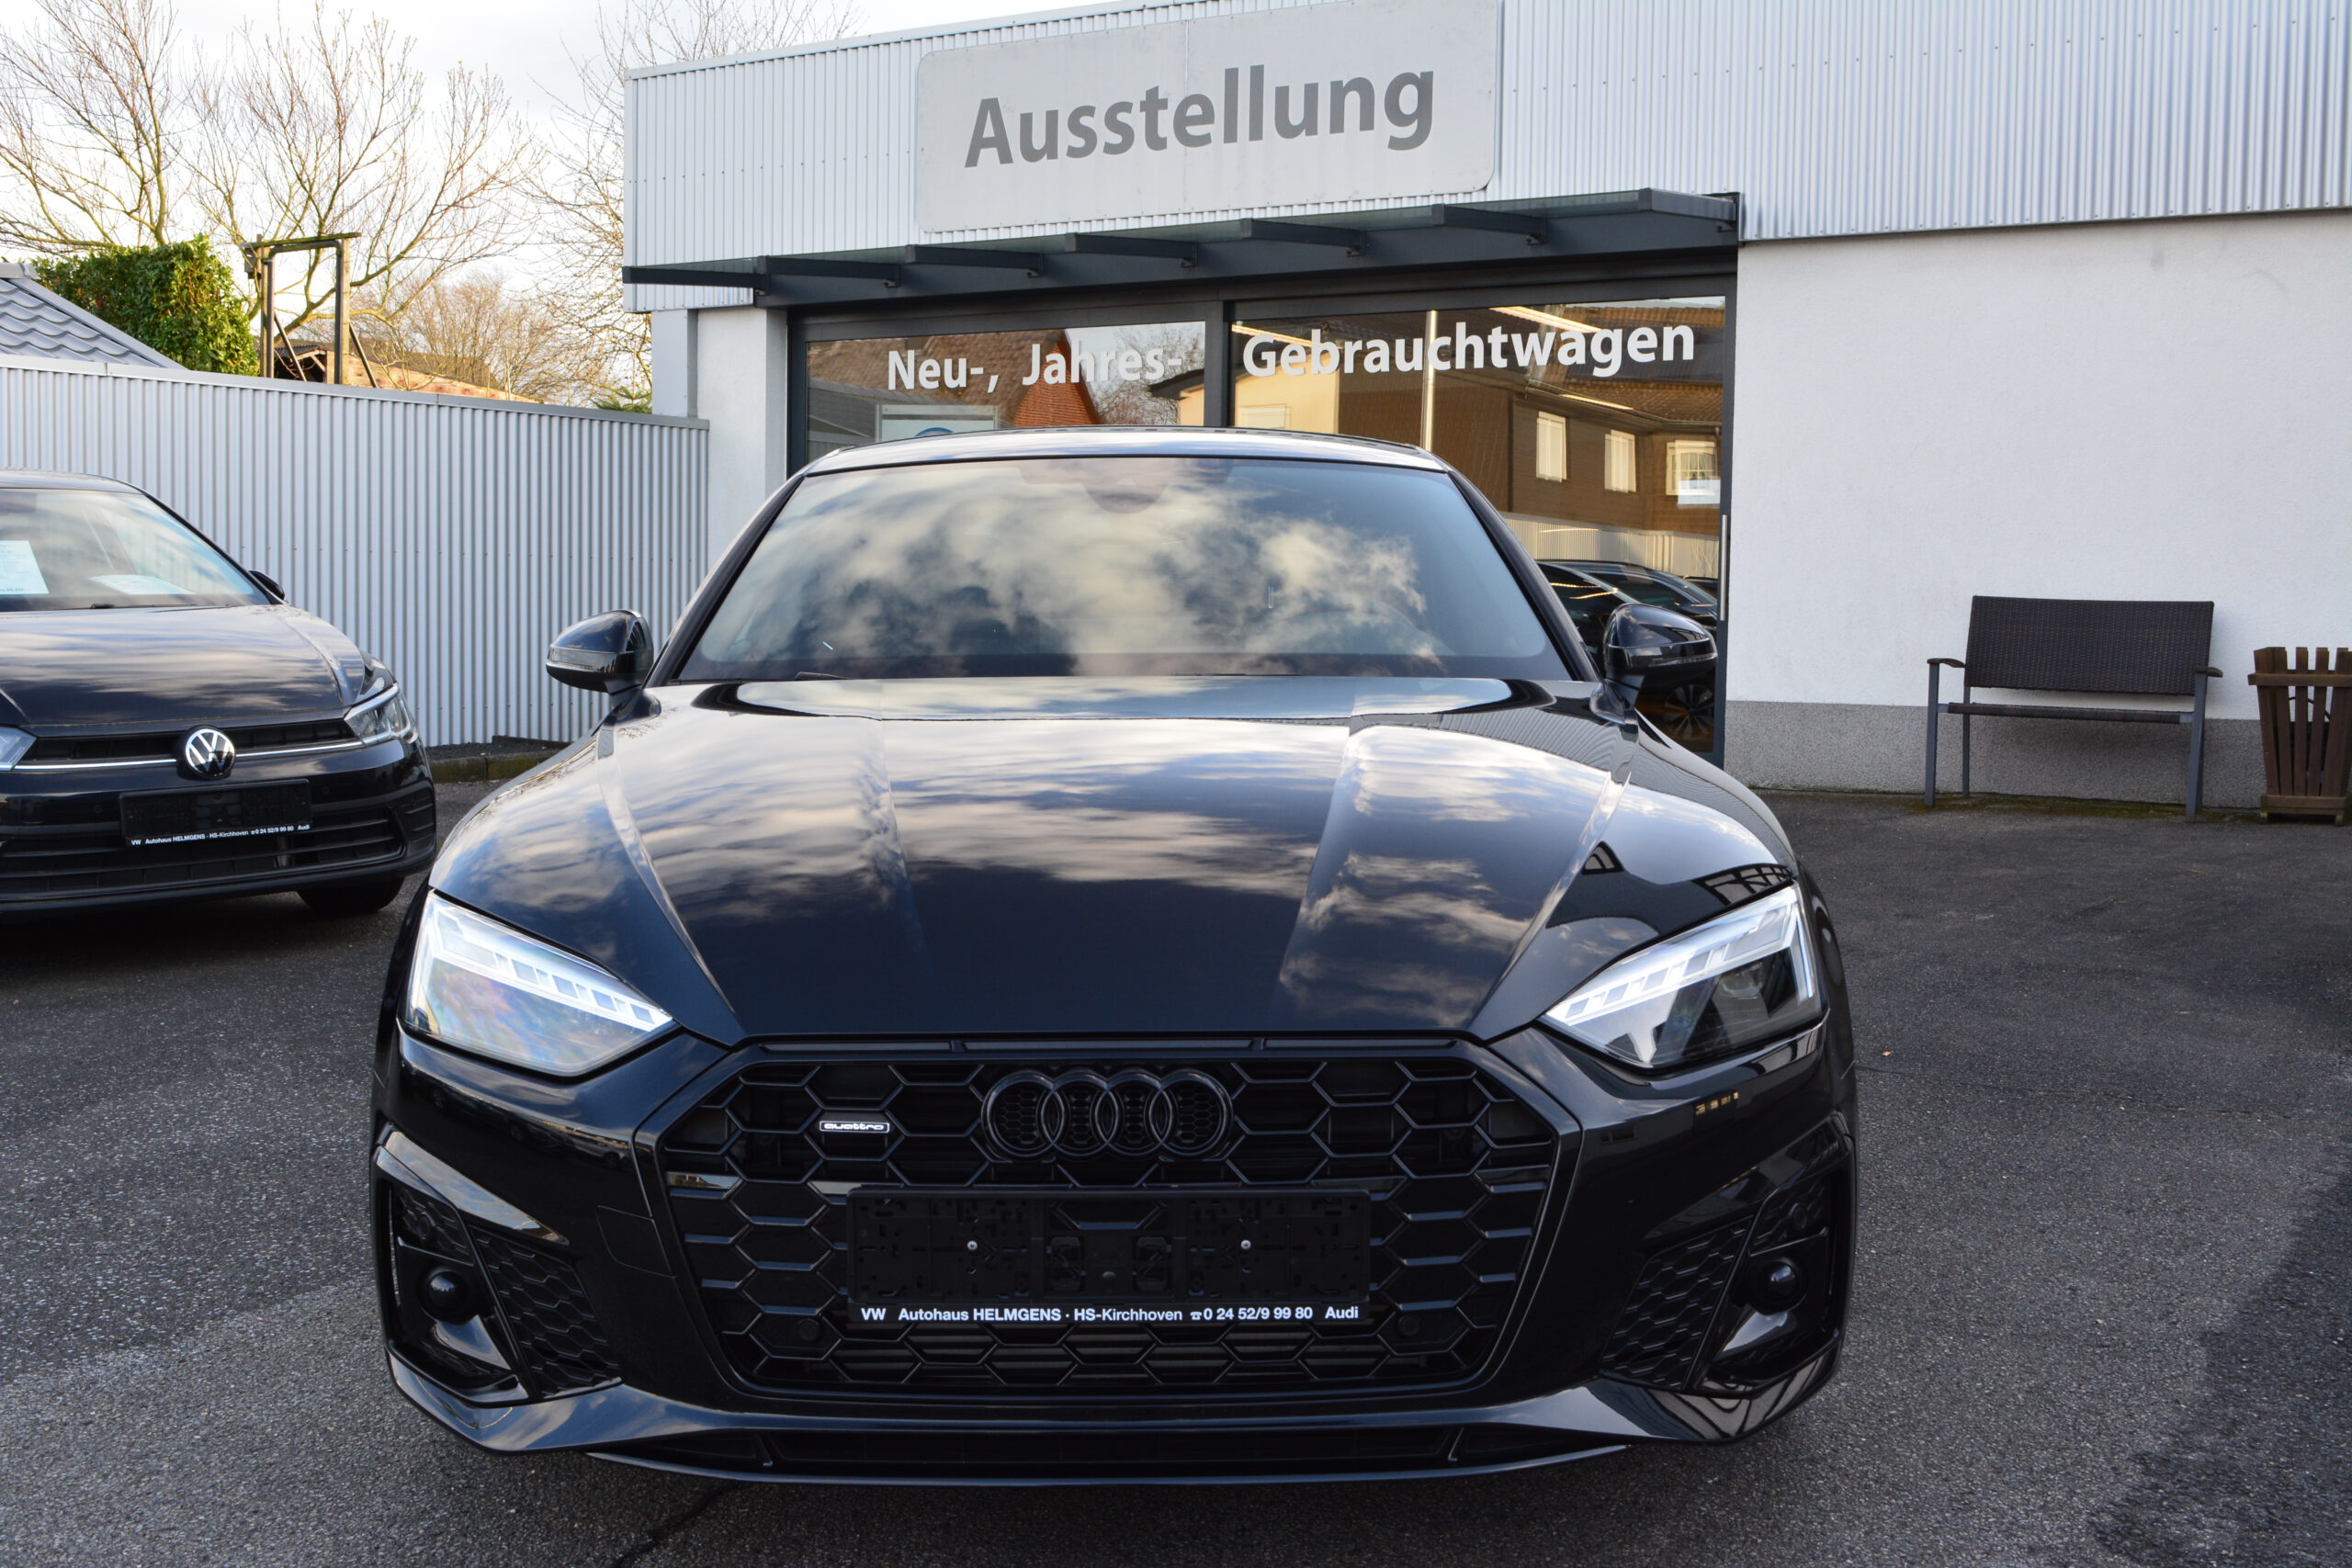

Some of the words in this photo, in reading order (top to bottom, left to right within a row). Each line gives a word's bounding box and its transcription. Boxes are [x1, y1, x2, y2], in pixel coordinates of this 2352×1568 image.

[965, 64, 1434, 168] Ausstellung
[888, 350, 1000, 393] Neu-,
[1022, 339, 1182, 386] Jahres-
[1242, 321, 1694, 378] Gebrauchtwagen
[145, 837, 173, 845] Autohaus
[172, 833, 206, 842] HELMGENS
[209, 828, 249, 839] HS-Kirchhoven
[823, 1122, 885, 1131] quattro
[860, 1307, 887, 1321] VW
[898, 1307, 969, 1321] Autohaus
[973, 1307, 1062, 1321] HELMGENS
[1073, 1307, 1183, 1321] HS-Kirchhoven
[1216, 1307, 1235, 1321] 24
[1238, 1306, 1271, 1320] 52/9
[1272, 1306, 1292, 1320] 99
[1295, 1306, 1314, 1320] 80
[1324, 1305, 1359, 1319] Audi
